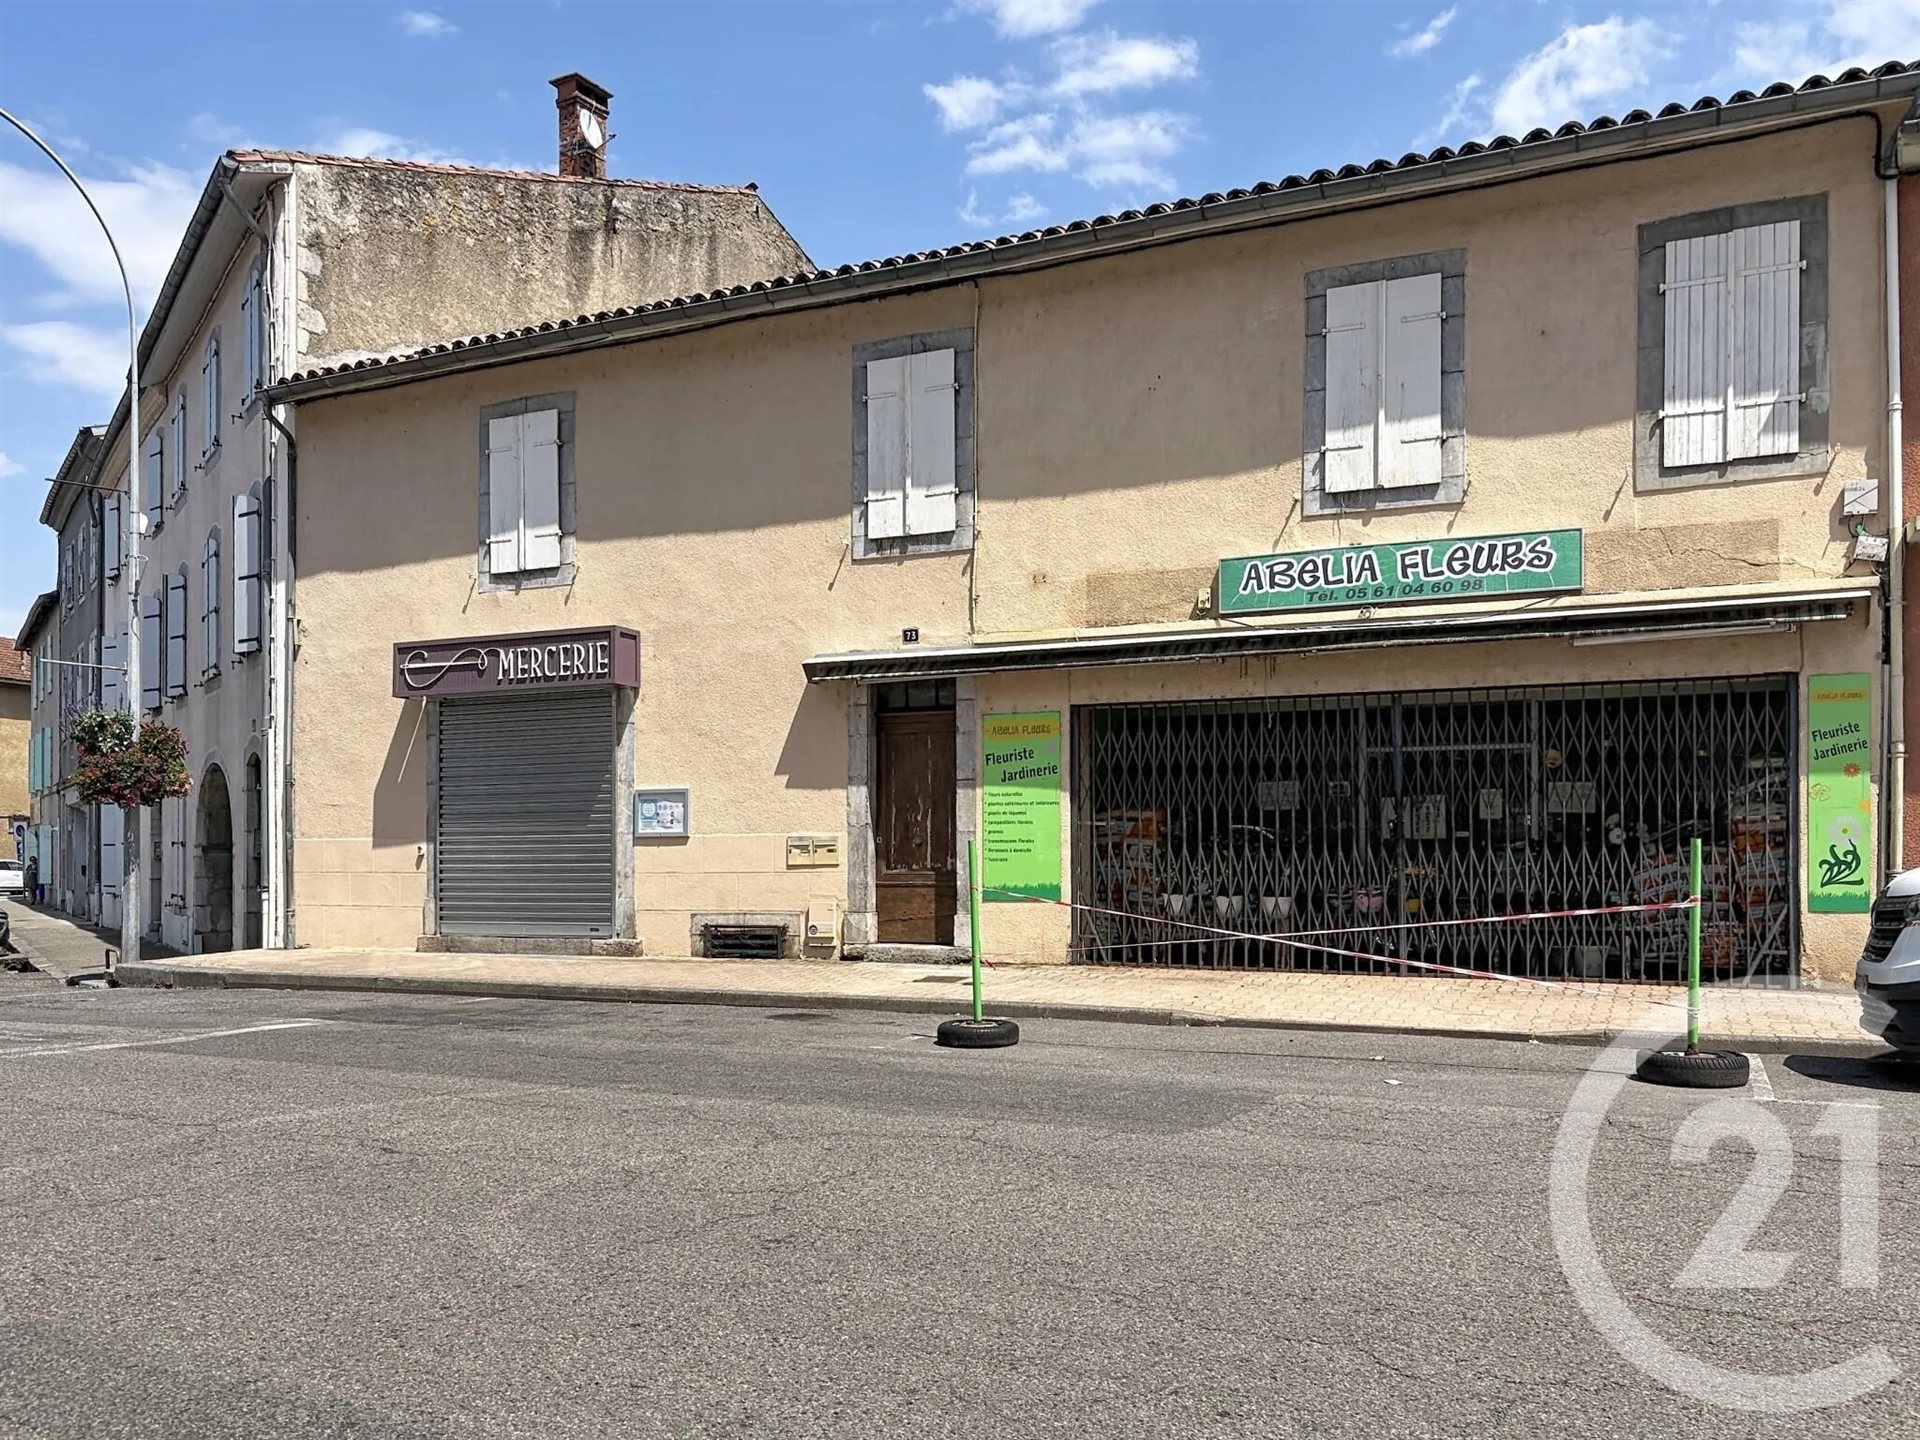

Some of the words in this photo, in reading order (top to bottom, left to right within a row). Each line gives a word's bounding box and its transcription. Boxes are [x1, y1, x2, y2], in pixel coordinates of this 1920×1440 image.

[1307, 590, 1338, 602] Tél.
[1346, 588, 1367, 599] 05
[1374, 586, 1394, 598] 61
[1402, 583, 1424, 595] 04
[1431, 581, 1453, 593] 60
[1460, 579, 1482, 591] 98
[905, 631, 916, 640] 73
[497, 641, 609, 680] MERCERIE
[1811, 722, 1860, 742] Fleuriste
[985, 747, 1034, 766] Fleuriste
[1811, 738, 1869, 760] Jardinerie
[1000, 762, 1058, 783] Jardinerie
